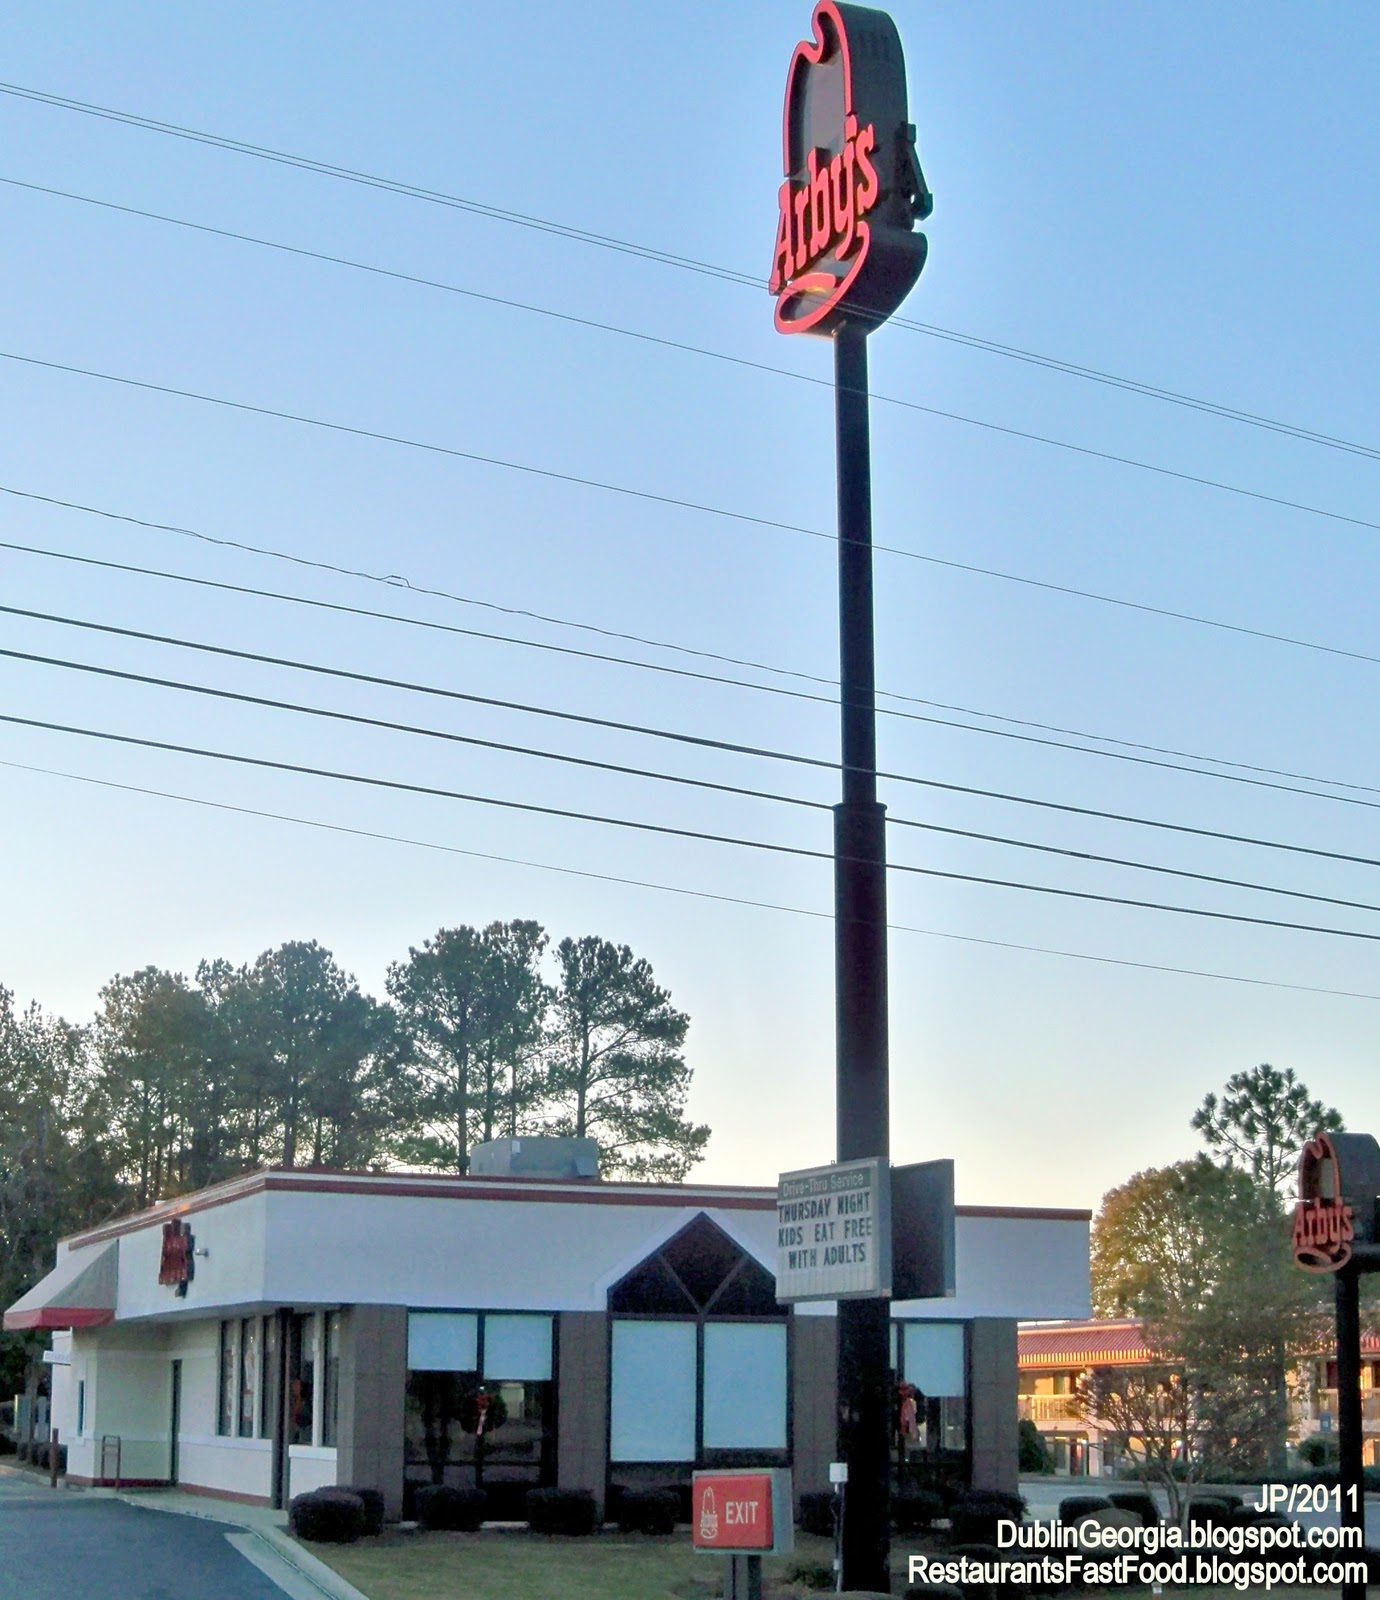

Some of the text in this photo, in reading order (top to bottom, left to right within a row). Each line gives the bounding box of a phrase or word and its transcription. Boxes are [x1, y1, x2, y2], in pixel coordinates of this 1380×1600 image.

[769, 114, 880, 296] Arby's
[783, 1172, 864, 1196] Drive-Thru Service
[778, 1191, 870, 1223] THURSDAY NIGHT
[778, 1217, 872, 1247] KIDS EAT FREE
[1292, 1196, 1354, 1254] Arby's
[789, 1243, 866, 1269] WITH ADULTS
[725, 1501, 758, 1524] EXIT
